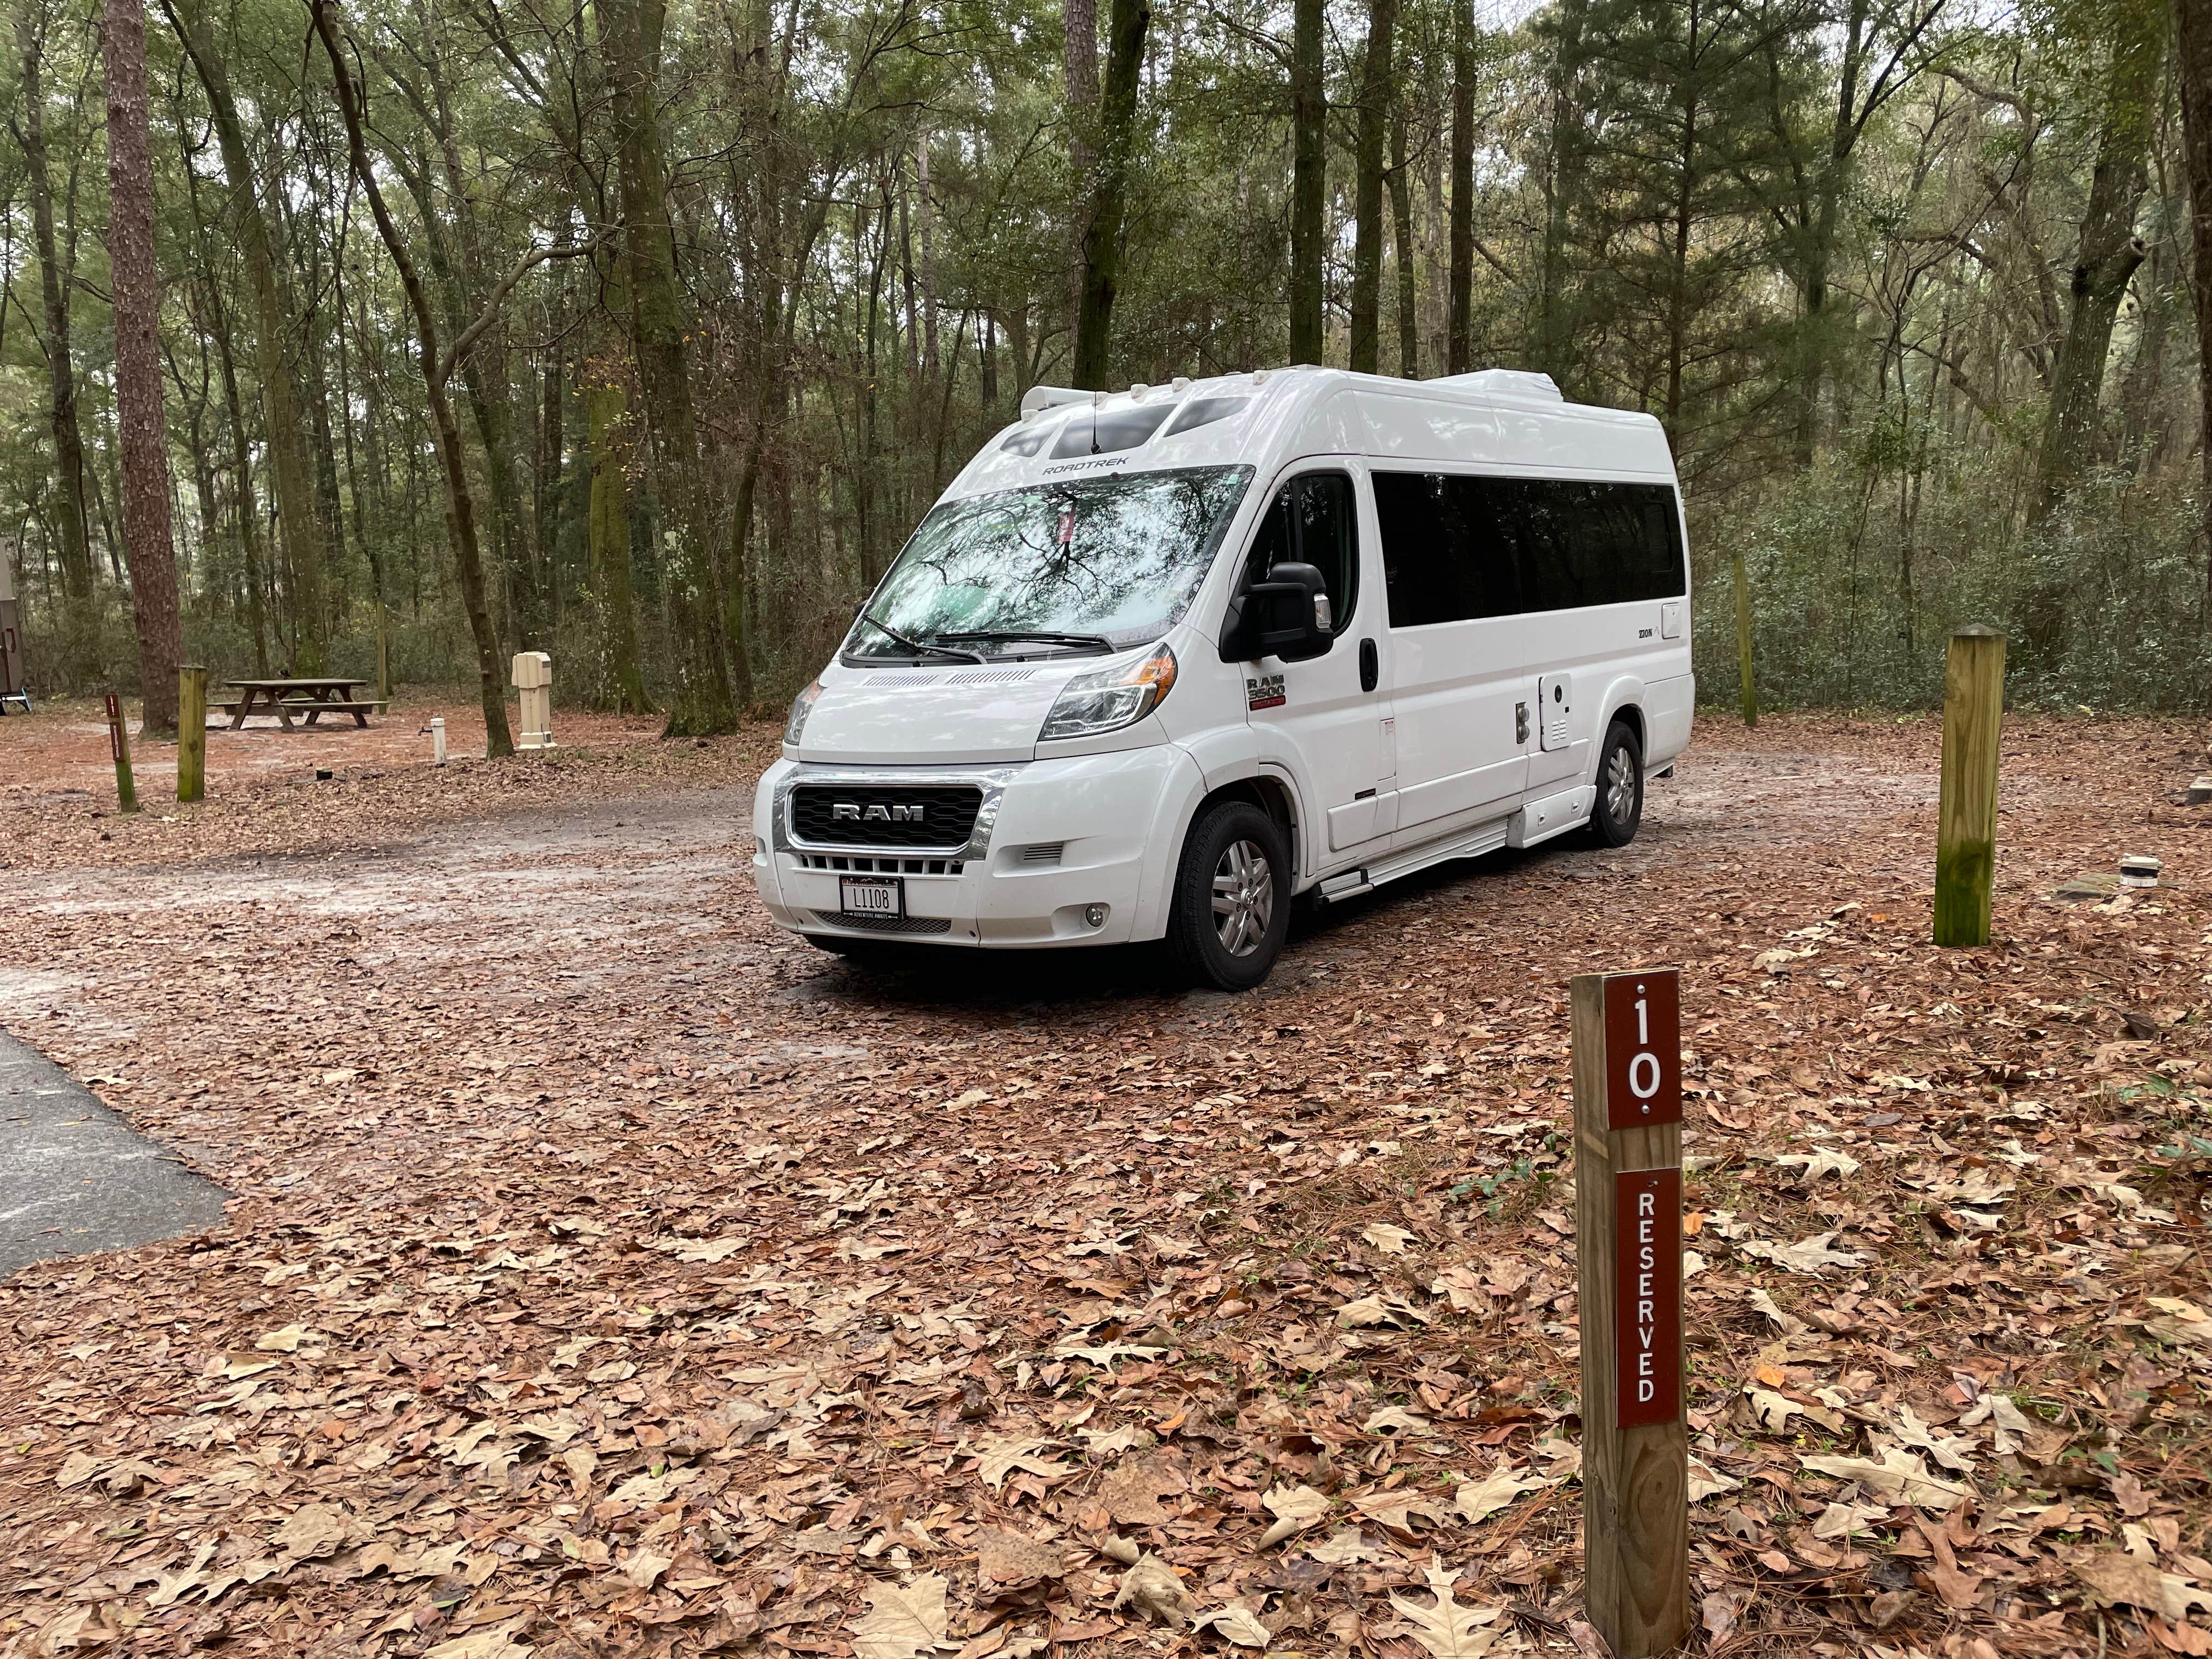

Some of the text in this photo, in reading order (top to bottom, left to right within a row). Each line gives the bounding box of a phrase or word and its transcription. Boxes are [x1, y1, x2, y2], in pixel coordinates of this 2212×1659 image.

[1042, 457, 1130, 476] ROADTREK
[1639, 628, 1652, 639] ZION
[1246, 674, 1284, 689] RAM
[1248, 685, 1285, 700] 3500
[833, 804, 923, 821] RAM
[854, 888, 889, 909] L1108
[1629, 999, 1661, 1099] 10
[1638, 1193, 1655, 1403] RESERVED
